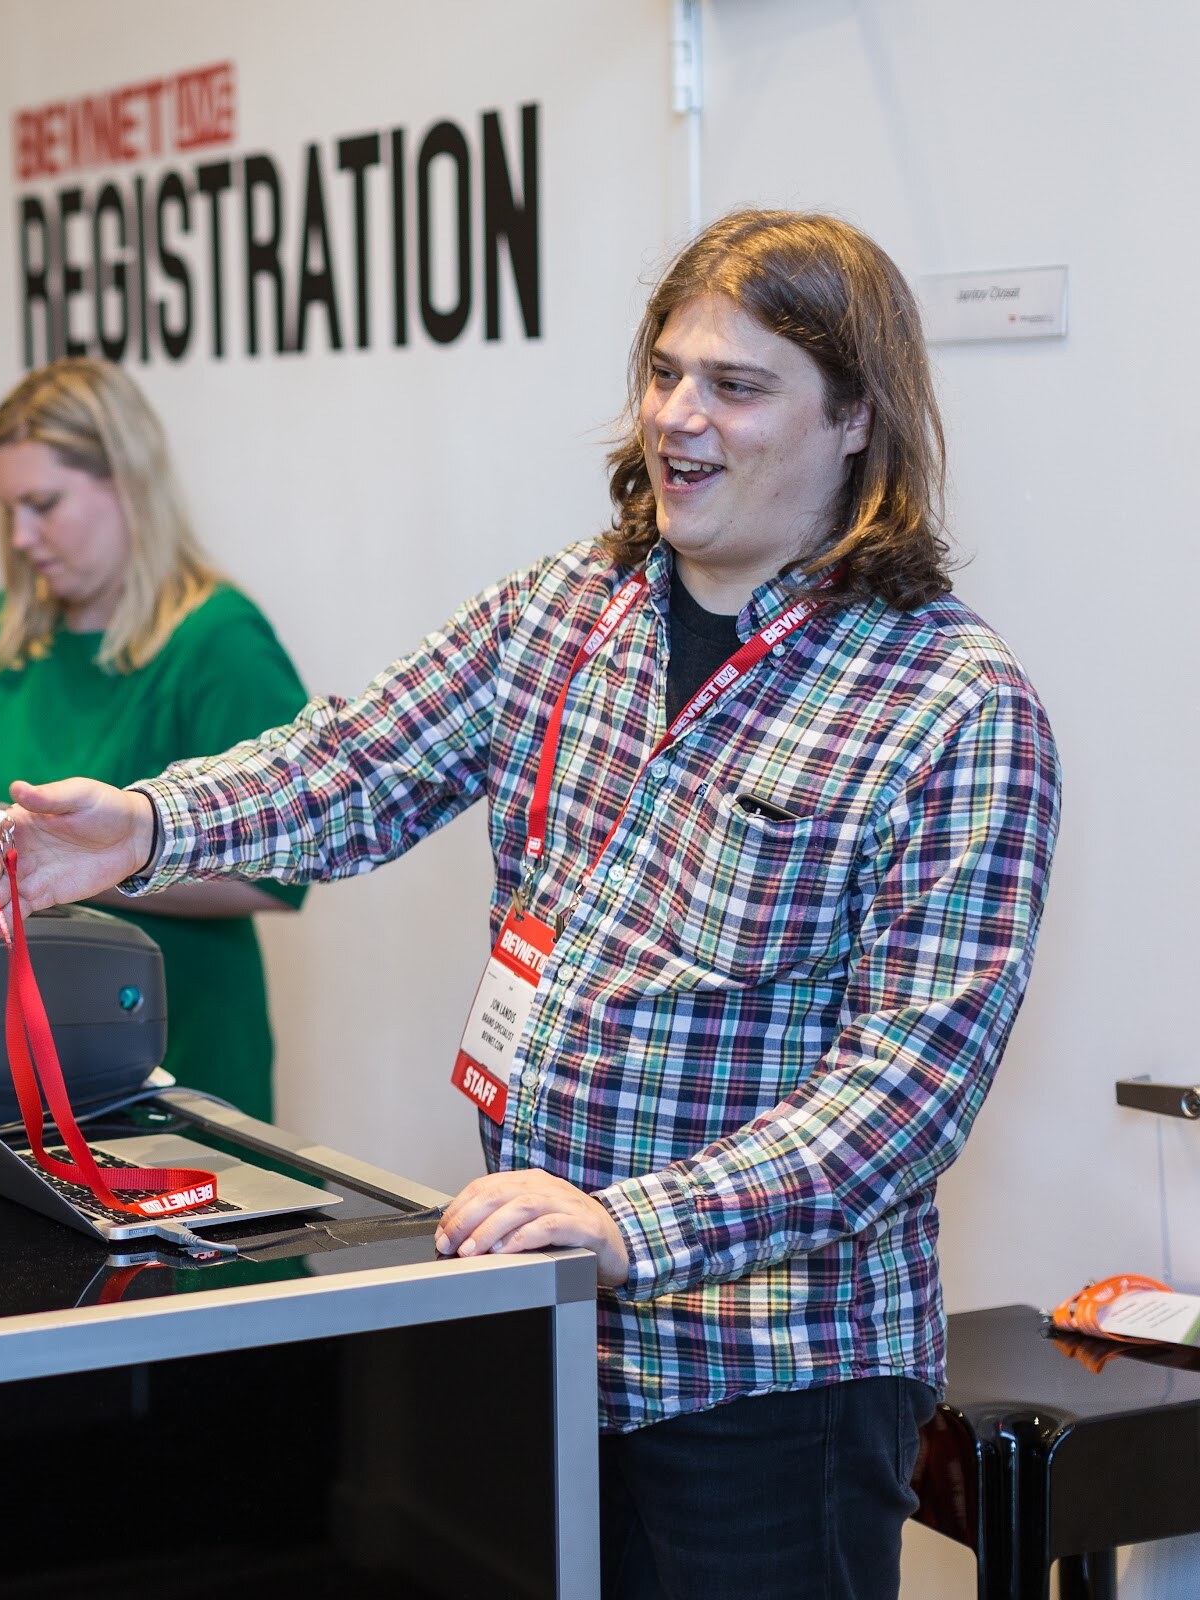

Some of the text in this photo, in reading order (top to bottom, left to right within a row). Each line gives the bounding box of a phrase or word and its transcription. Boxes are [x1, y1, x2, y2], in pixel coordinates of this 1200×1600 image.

[16, 84, 163, 180] BEVNET
[18, 103, 543, 366] REGISTRATION
[585, 581, 643, 654] BEVNET LIVE
[670, 666, 738, 735] BEVNET LIVE
[500, 928, 541, 970] BEVNET
[481, 1012, 514, 1042] BRAND SPECIALIST
[499, 1004, 517, 1024] LANDIS
[481, 1030, 504, 1053] BEVNET.COM
[462, 1065, 498, 1108] STAFF
[161, 1183, 213, 1212] BEVNET
